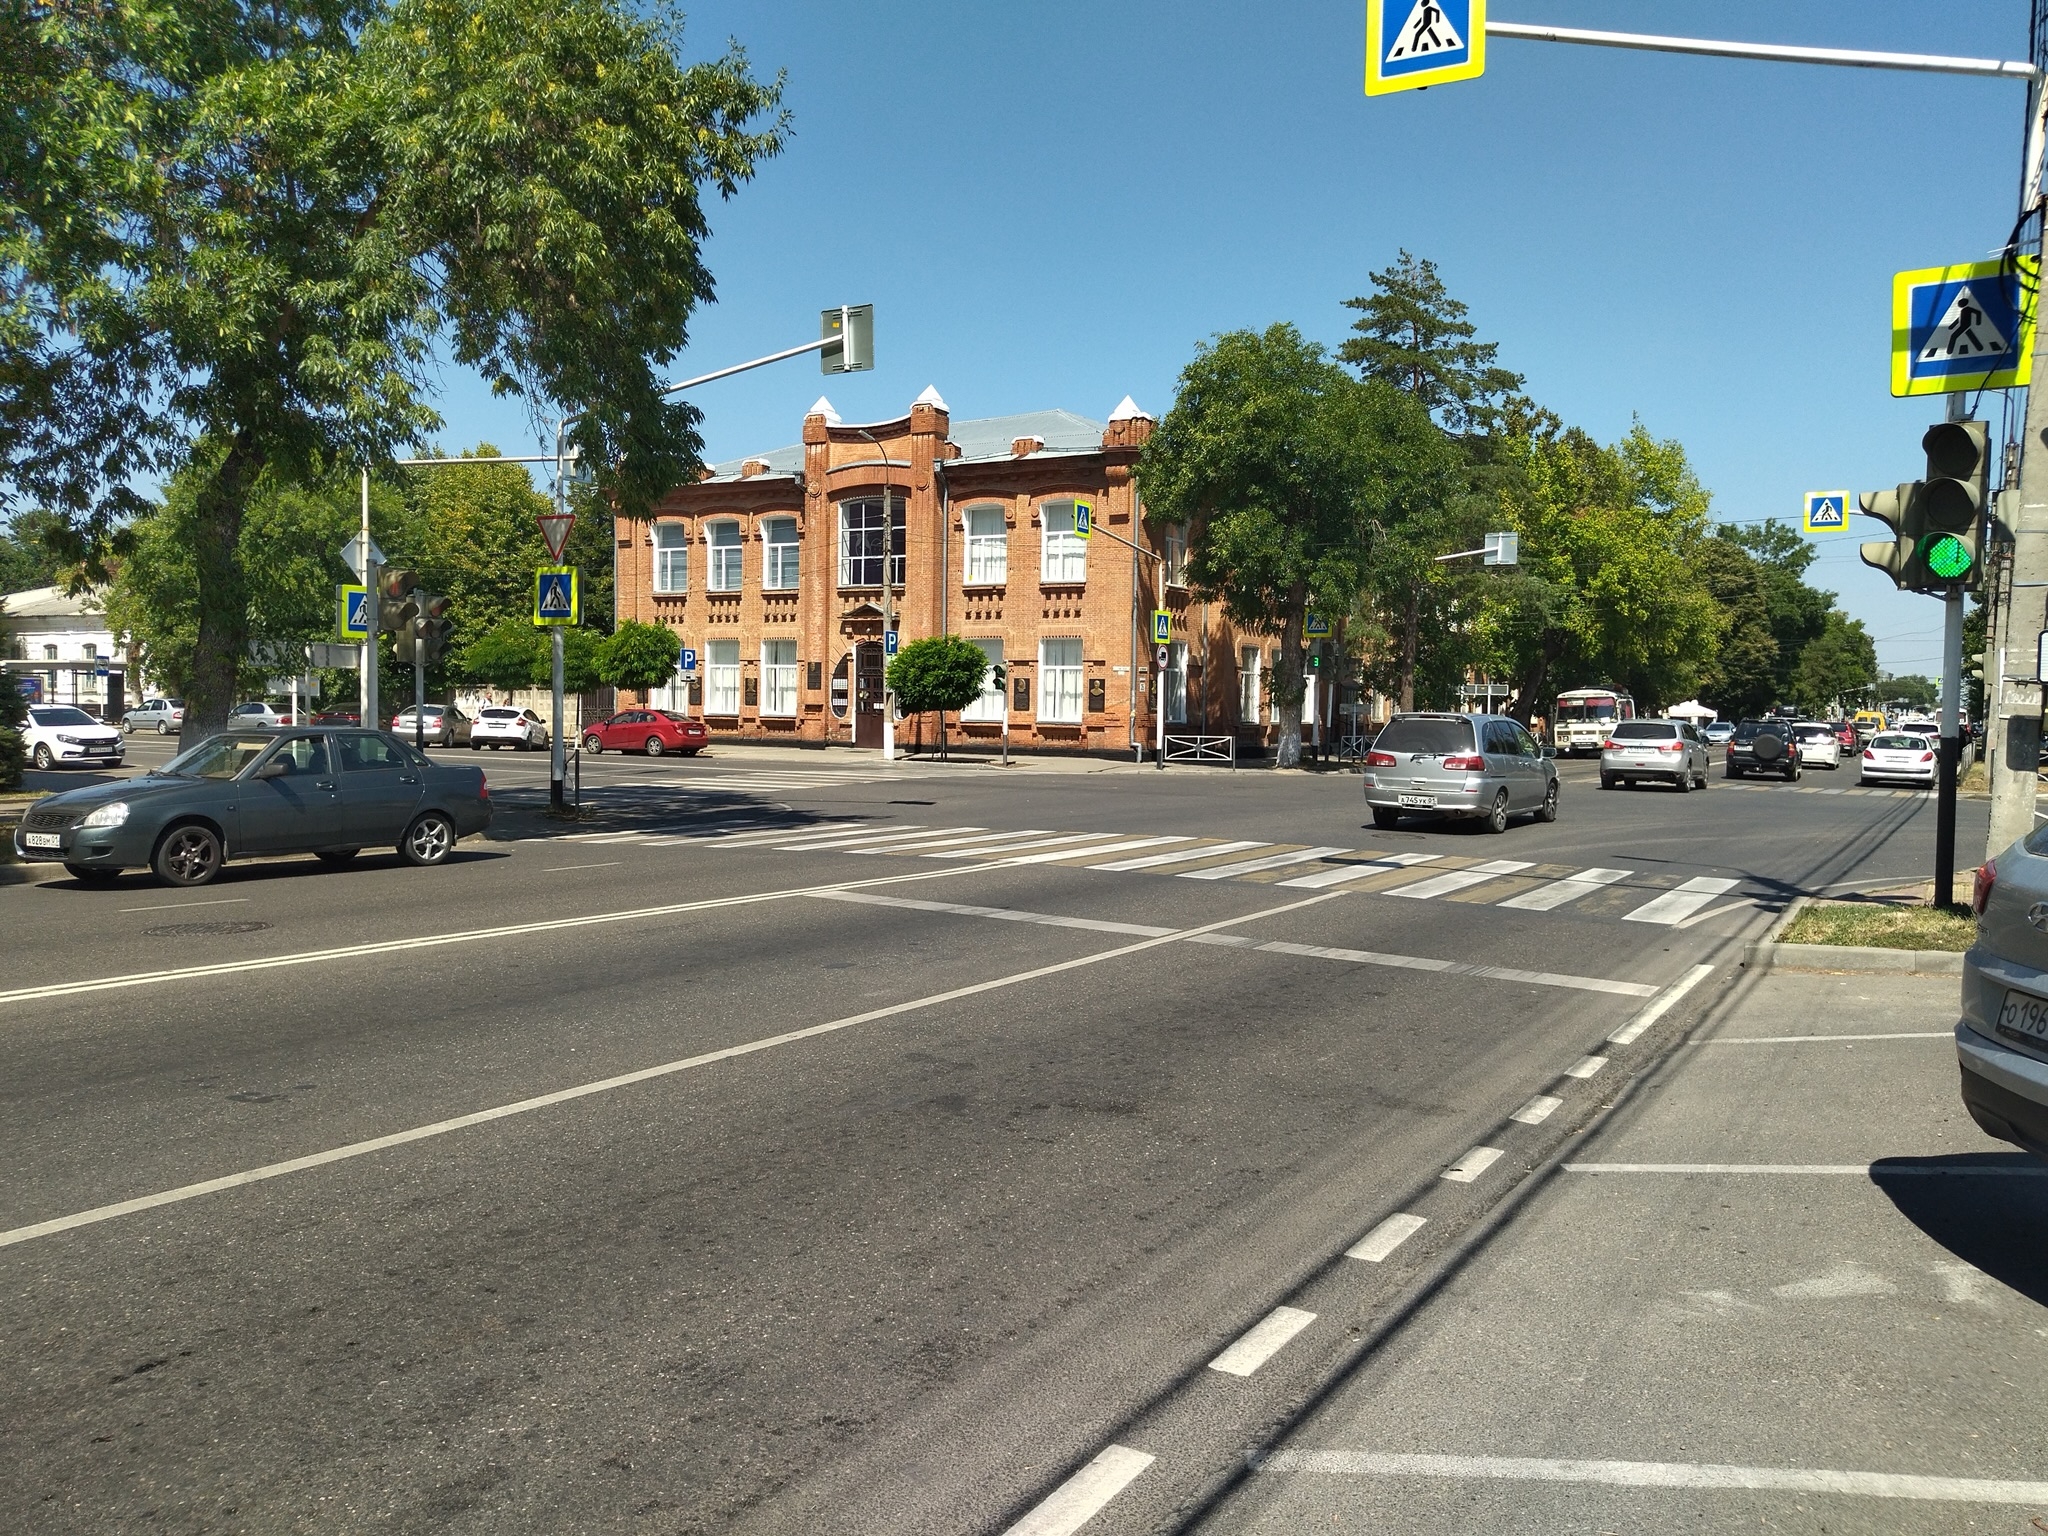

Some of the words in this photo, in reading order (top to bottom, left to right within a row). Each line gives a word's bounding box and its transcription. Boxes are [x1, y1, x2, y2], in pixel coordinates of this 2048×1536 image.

[888, 633, 896, 651] P
[684, 651, 694, 668] P
[1314, 657, 1319, 666] 3
